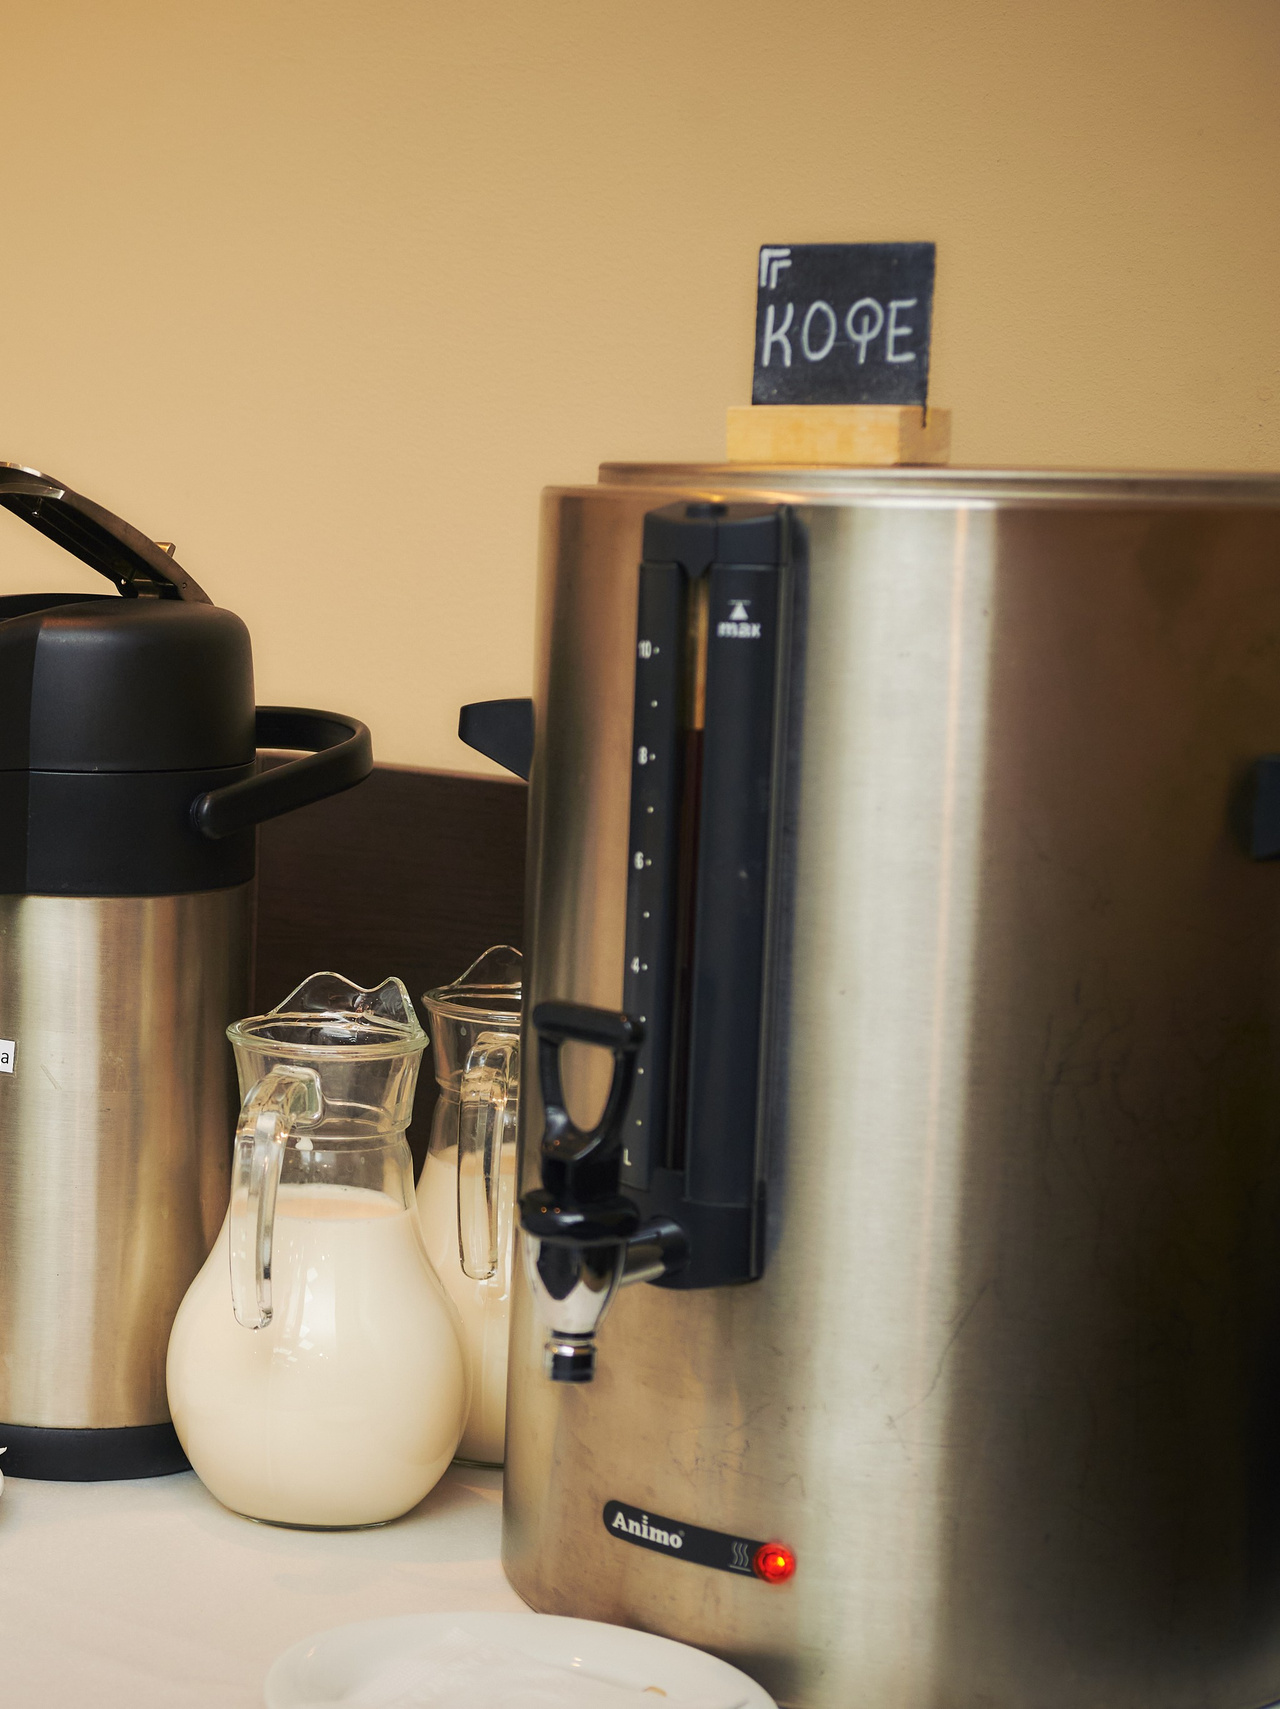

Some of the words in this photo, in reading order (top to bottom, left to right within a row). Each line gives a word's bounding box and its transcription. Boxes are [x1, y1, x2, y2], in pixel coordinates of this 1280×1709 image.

[761, 297, 917, 368] КОФЕ
[717, 621, 762, 639] max
[631, 956, 640, 974] 4
[611, 1511, 683, 1549] Animo
